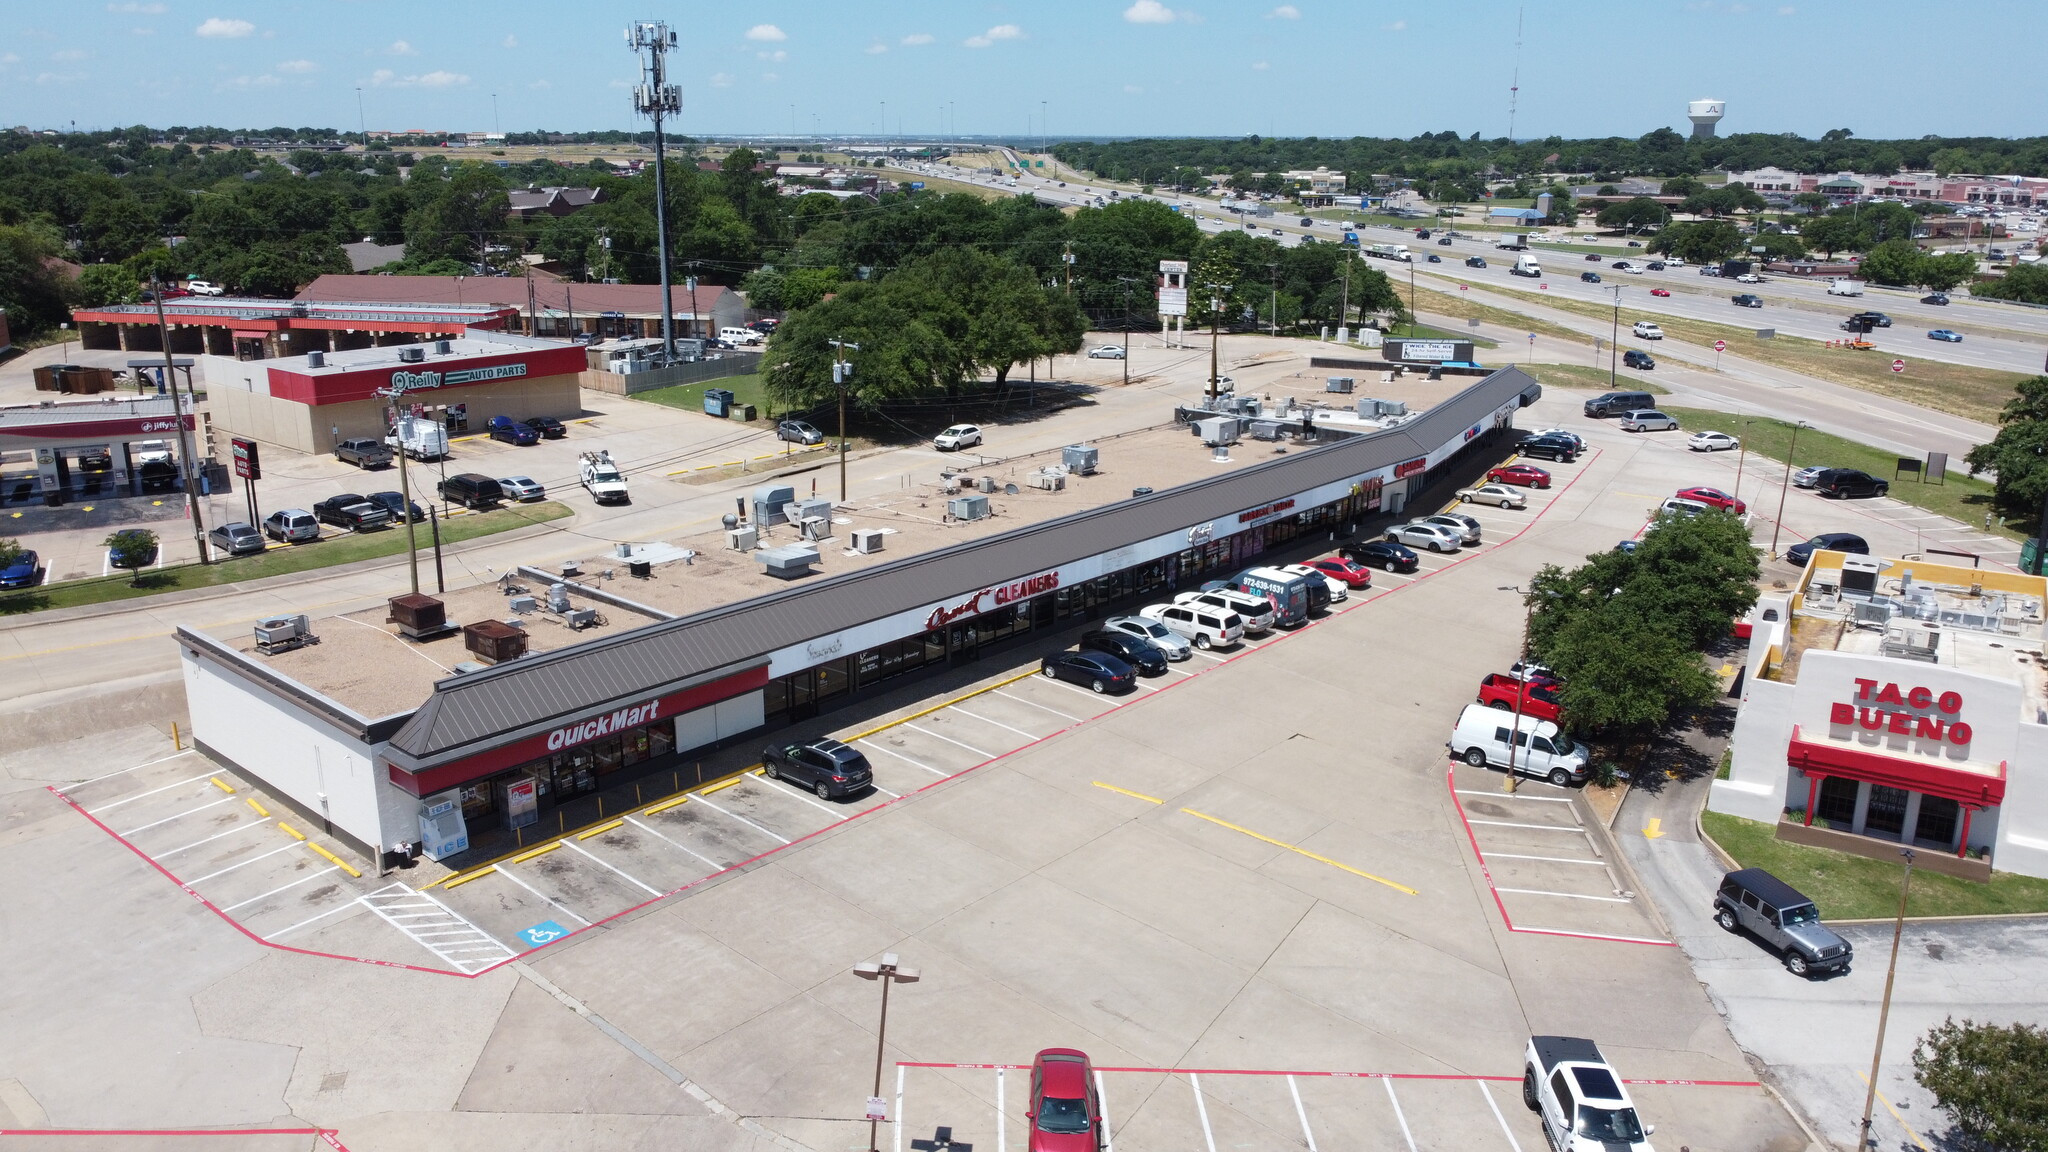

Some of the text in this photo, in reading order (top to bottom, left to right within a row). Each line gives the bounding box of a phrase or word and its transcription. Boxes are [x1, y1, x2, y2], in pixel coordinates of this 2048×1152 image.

[392, 365, 526, 390] O'Reilly AUTO PARTS
[994, 571, 1059, 605] CLEANERS
[1855, 678, 1963, 714] TACO
[547, 699, 659, 751] QuickMart
[1830, 703, 1972, 745] BUENO
[437, 836, 468, 856] ICE
